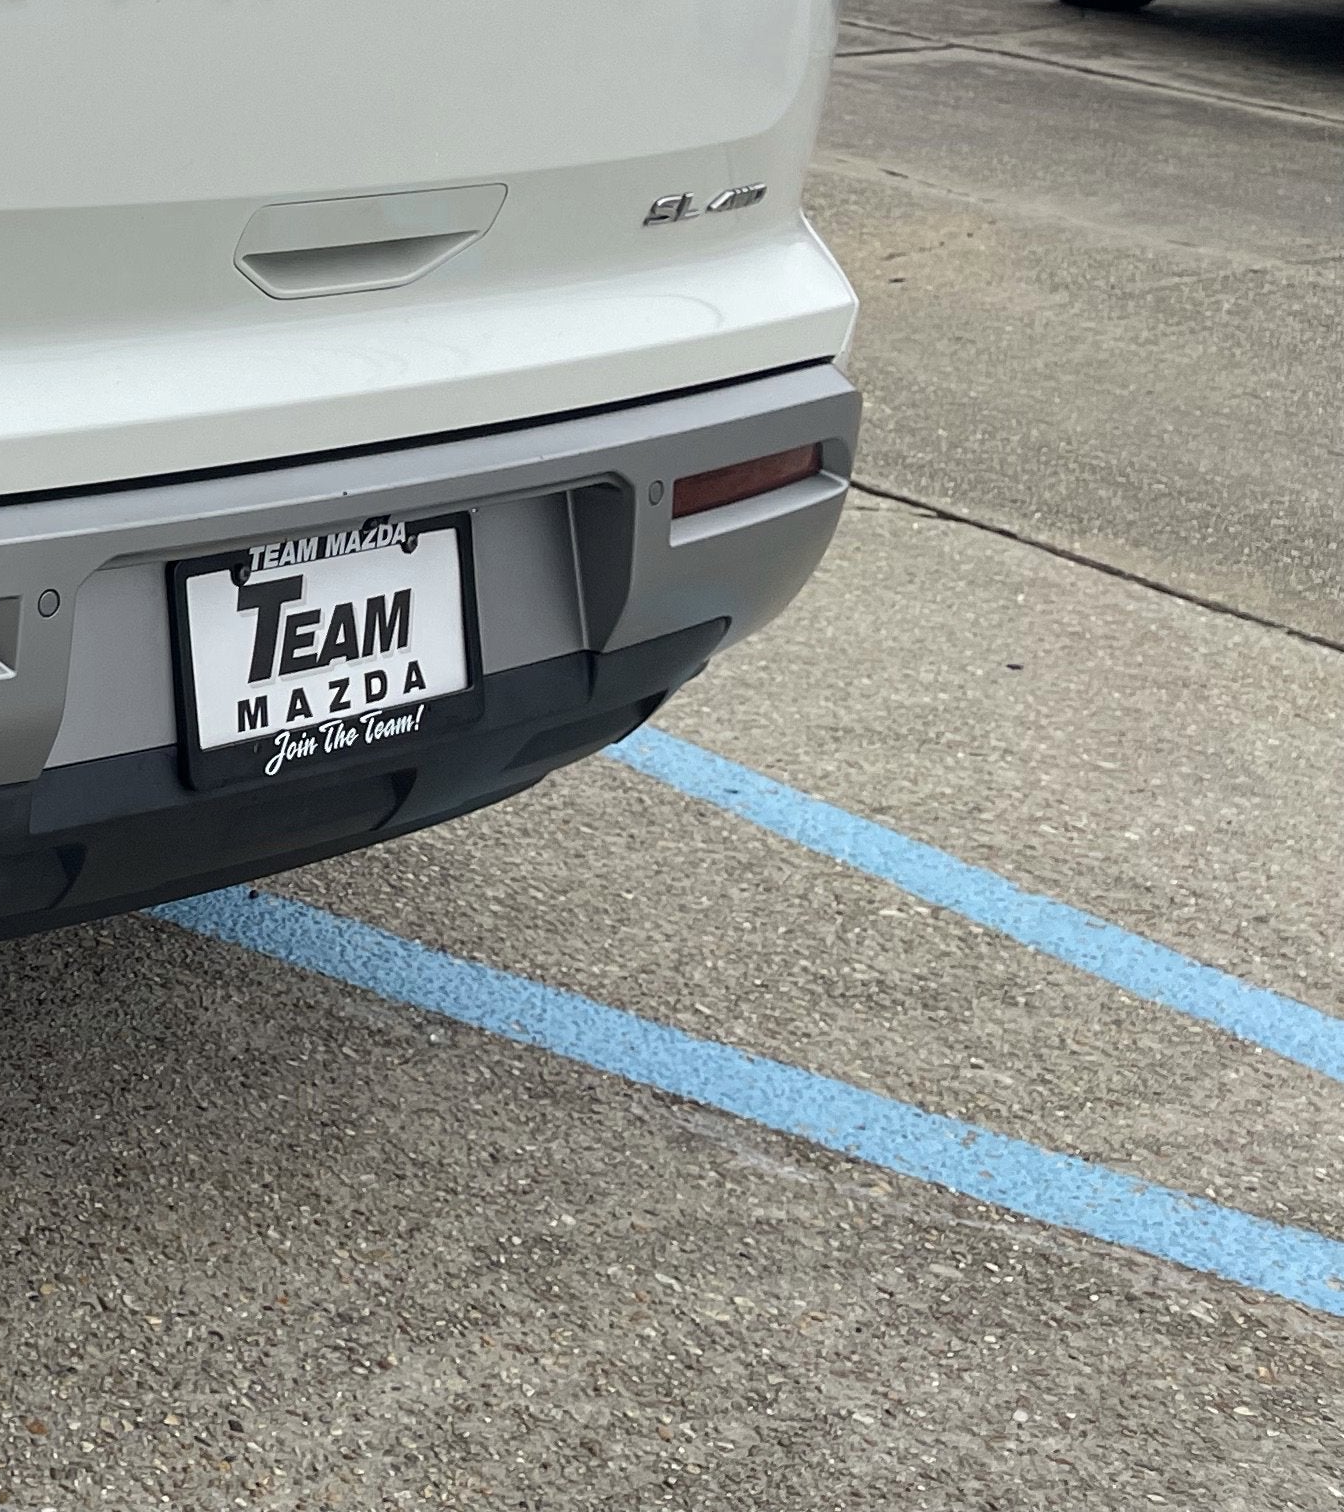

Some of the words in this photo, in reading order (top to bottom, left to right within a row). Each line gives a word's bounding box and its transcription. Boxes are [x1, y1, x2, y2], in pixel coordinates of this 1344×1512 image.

[642, 192, 701, 227] SL
[248, 537, 318, 572] TEAM
[324, 521, 408, 557] MAZDA
[237, 574, 412, 685] TEAM
[237, 660, 427, 733] MAZDA
[265, 731, 318, 776] Join
[318, 719, 359, 754] The
[360, 704, 425, 744] Team!
